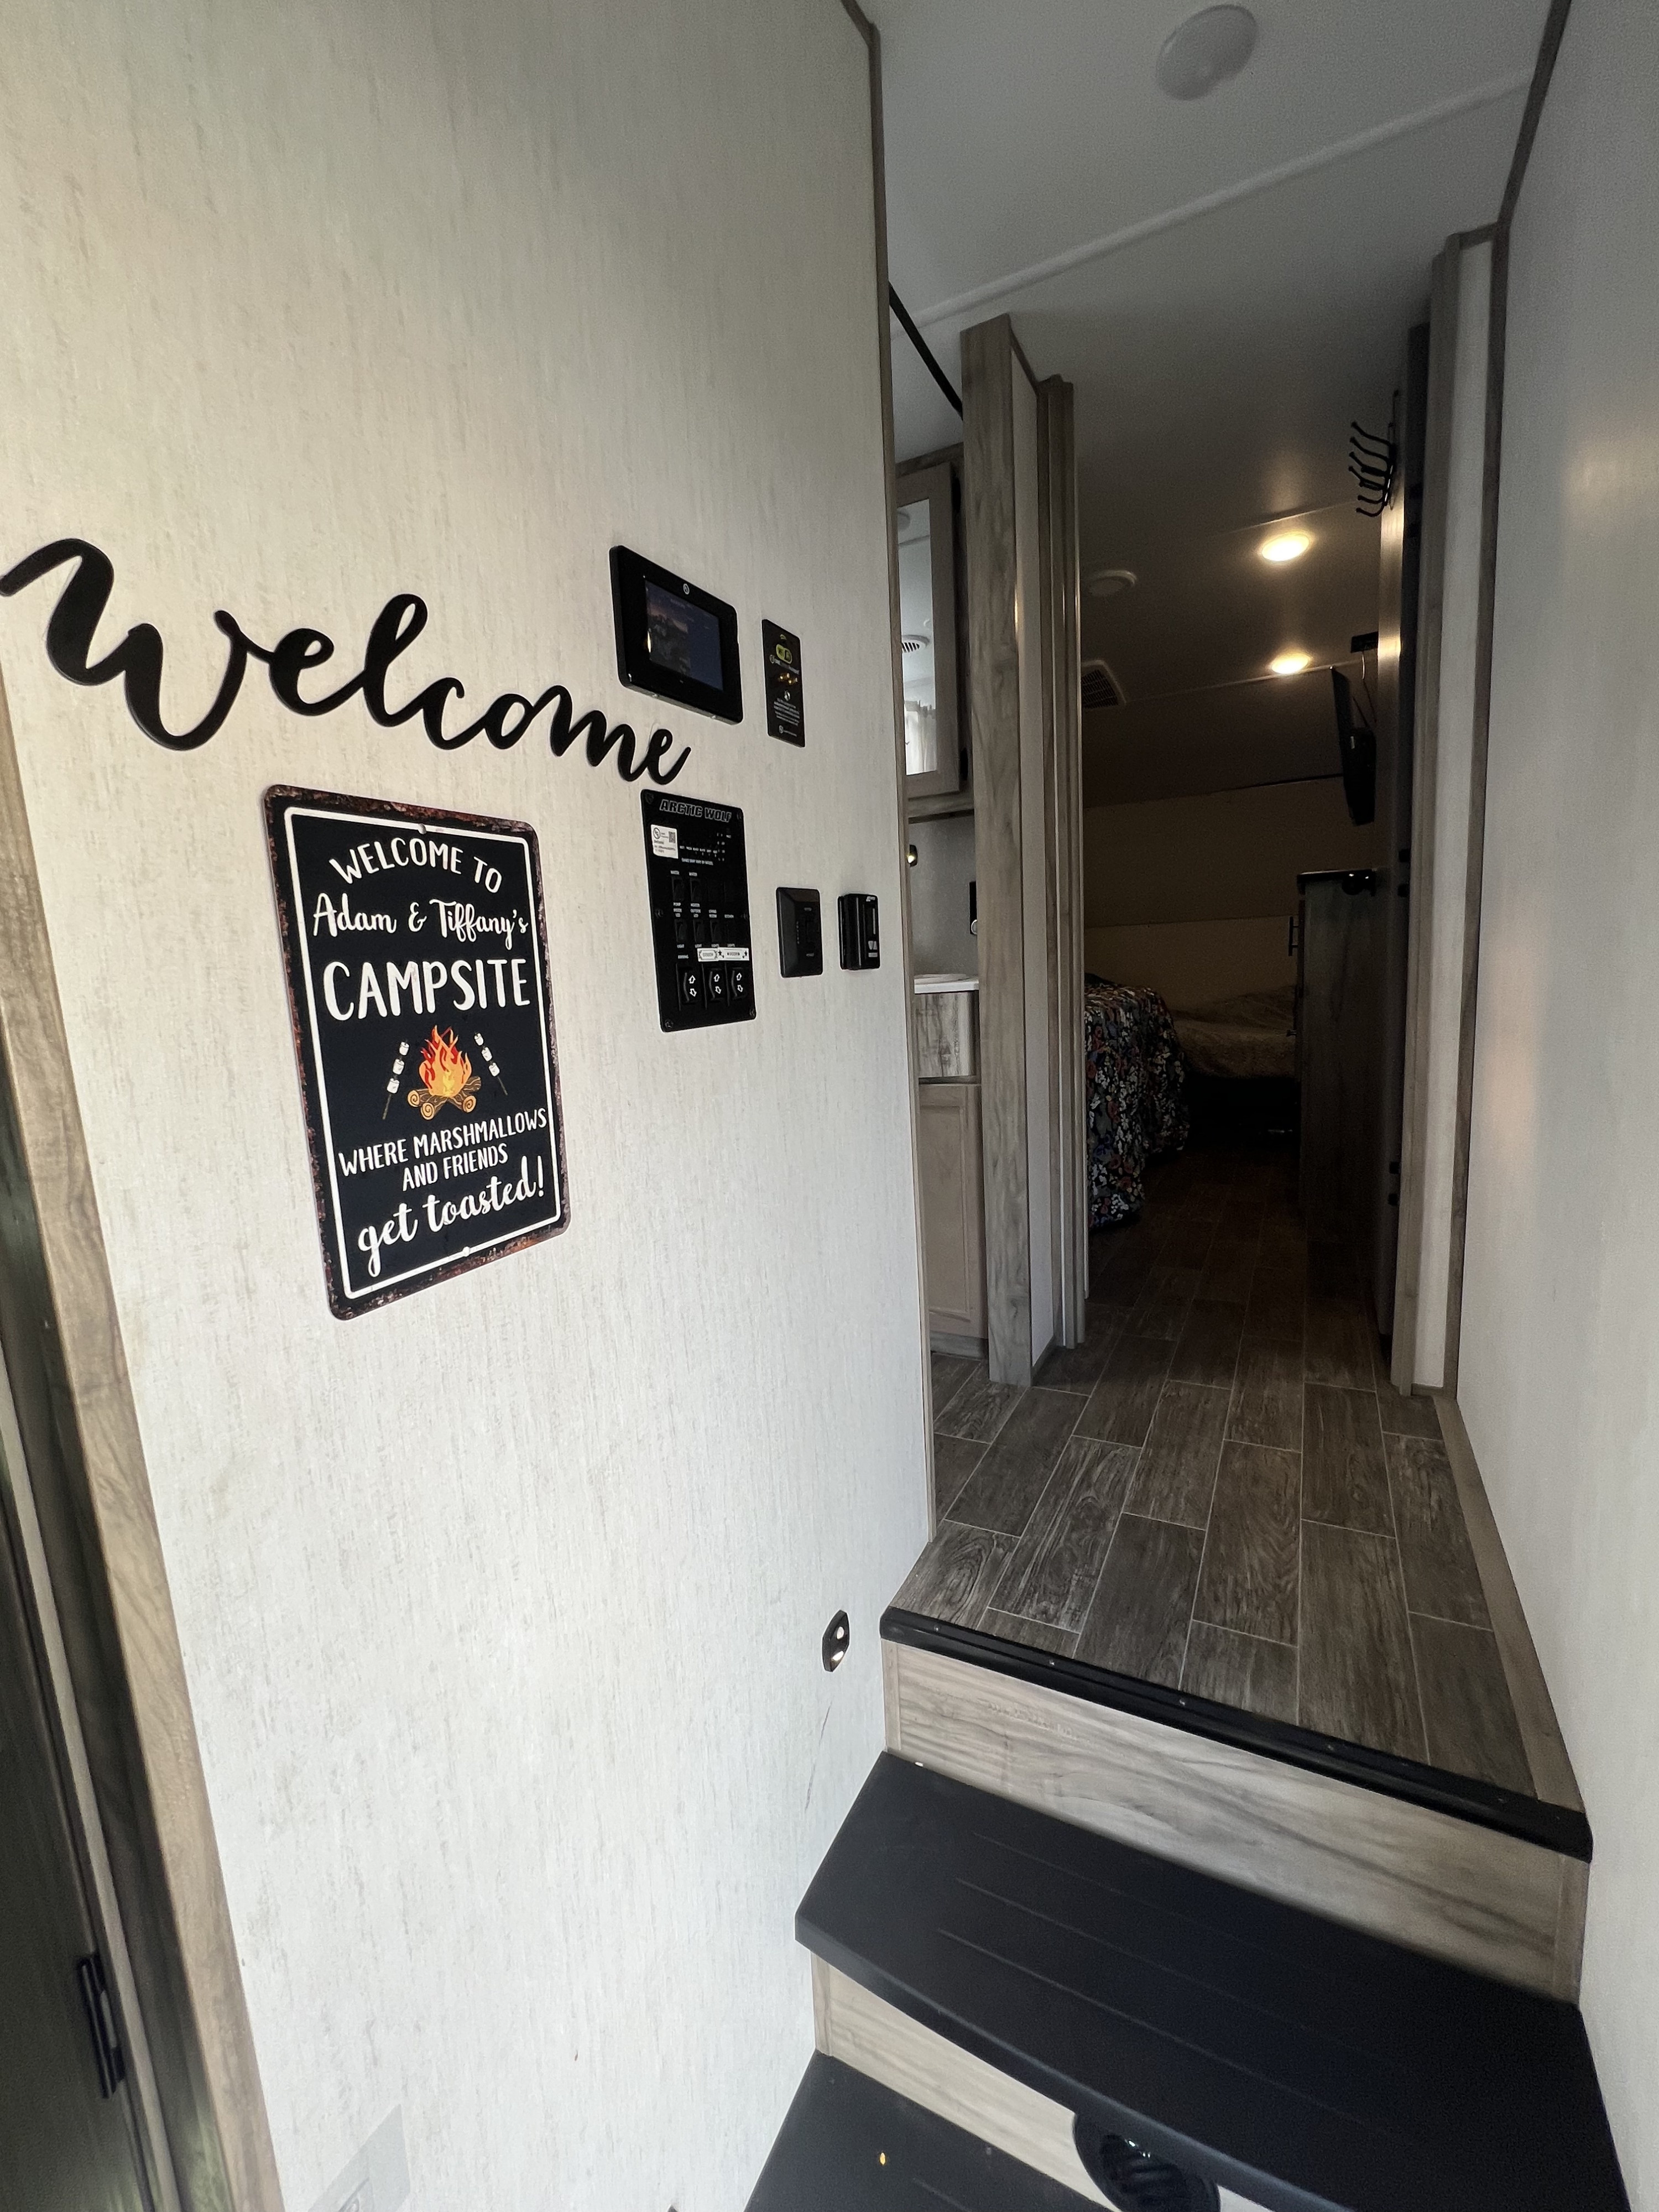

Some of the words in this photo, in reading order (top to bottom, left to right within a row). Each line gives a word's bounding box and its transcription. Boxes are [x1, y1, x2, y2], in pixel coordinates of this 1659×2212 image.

[659, 799, 703, 817] ARCTIC
[705, 807, 732, 823] WOLF
[328, 837, 463, 884] WELCOME
[474, 857, 503, 893] TO
[313, 893, 397, 937] Adam
[408, 902, 427, 932] &
[429, 899, 529, 950] Tiffany's
[324, 958, 530, 1021] CAMPSITE
[338, 1139, 409, 1177] WHERE
[414, 1108, 547, 1159] MARSHMALLOWS
[403, 1161, 439, 1192] AND
[443, 1142, 509, 1180] FRIENDS
[358, 1203, 418, 1277] get
[424, 1155, 545, 1232] toasted!
